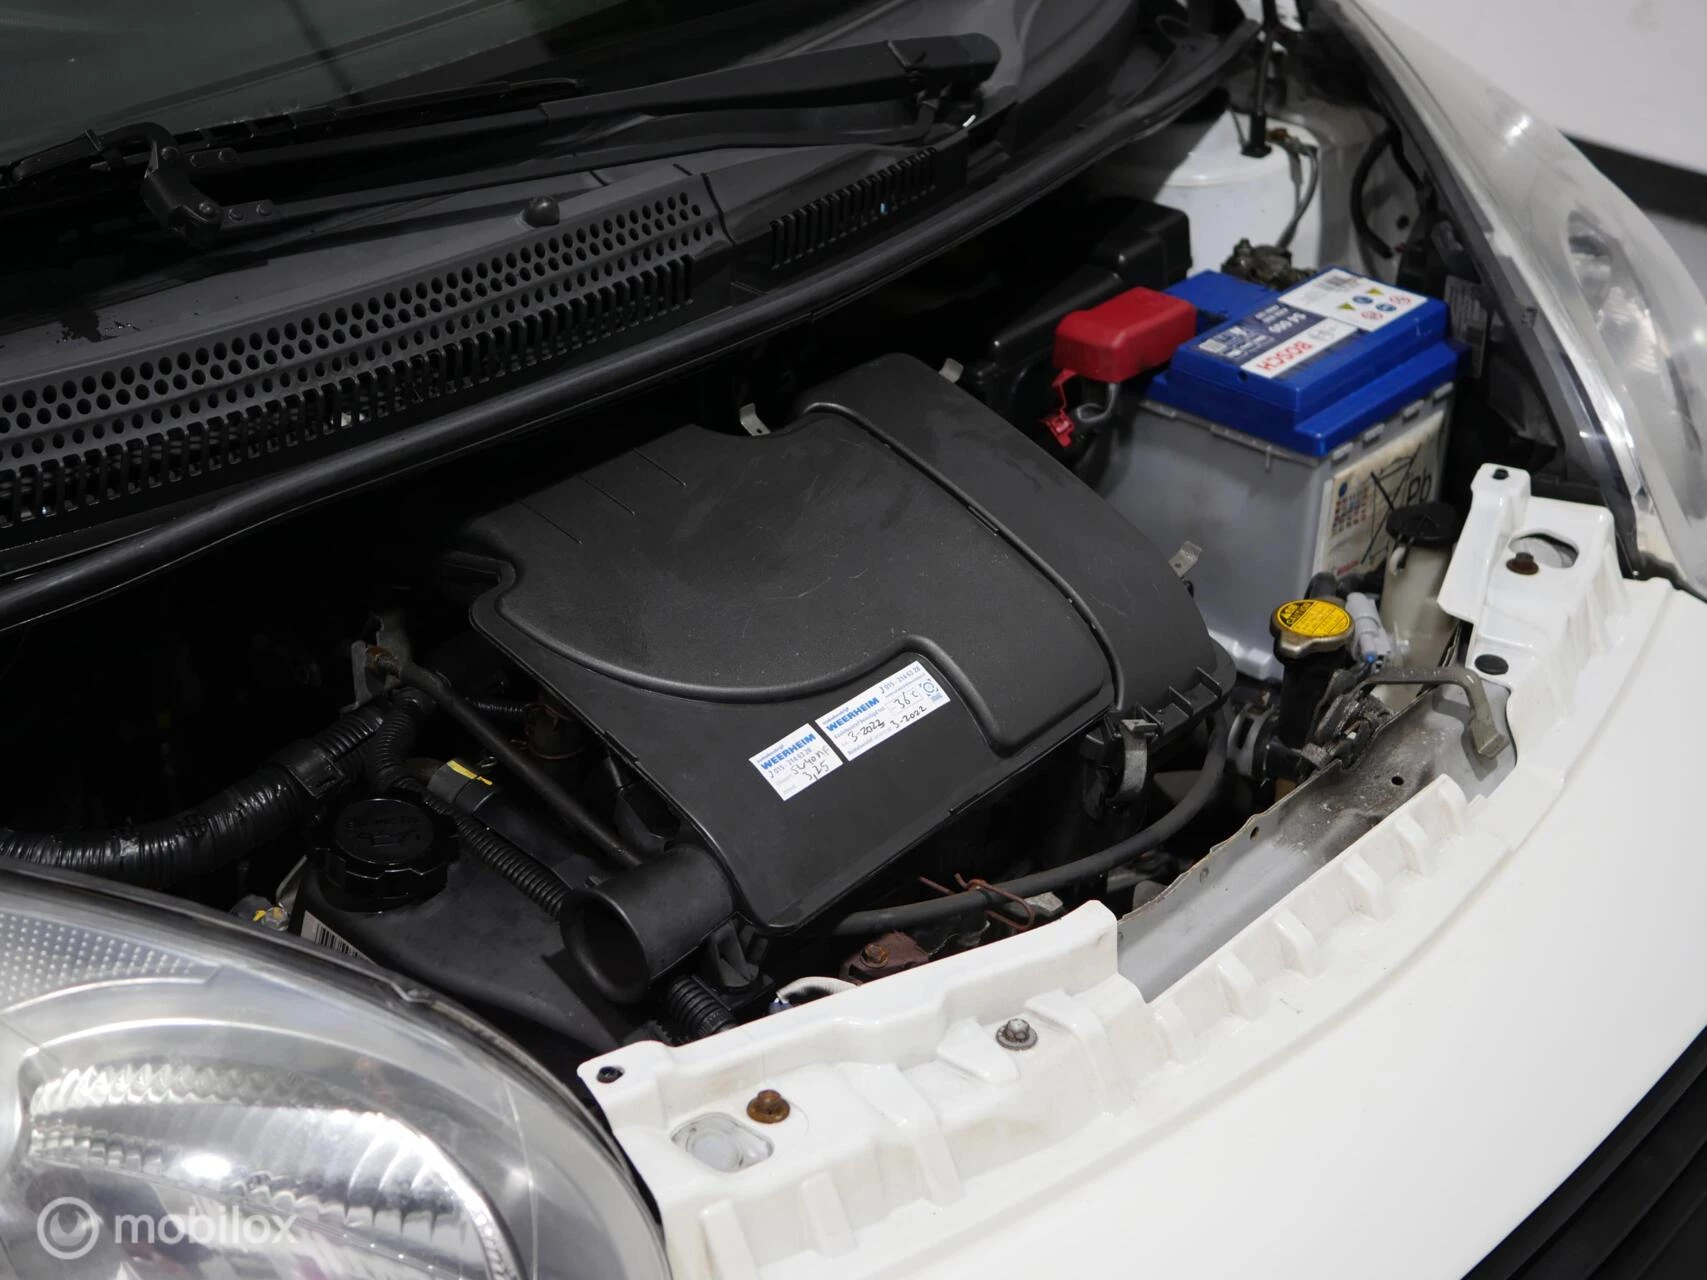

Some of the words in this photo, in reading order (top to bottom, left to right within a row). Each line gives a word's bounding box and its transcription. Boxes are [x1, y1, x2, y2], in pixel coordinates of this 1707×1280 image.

[1256, 341, 1313, 371] BOSCH
[826, 697, 880, 732] WEERHEIM
[761, 733, 817, 770] WEERHEIM
